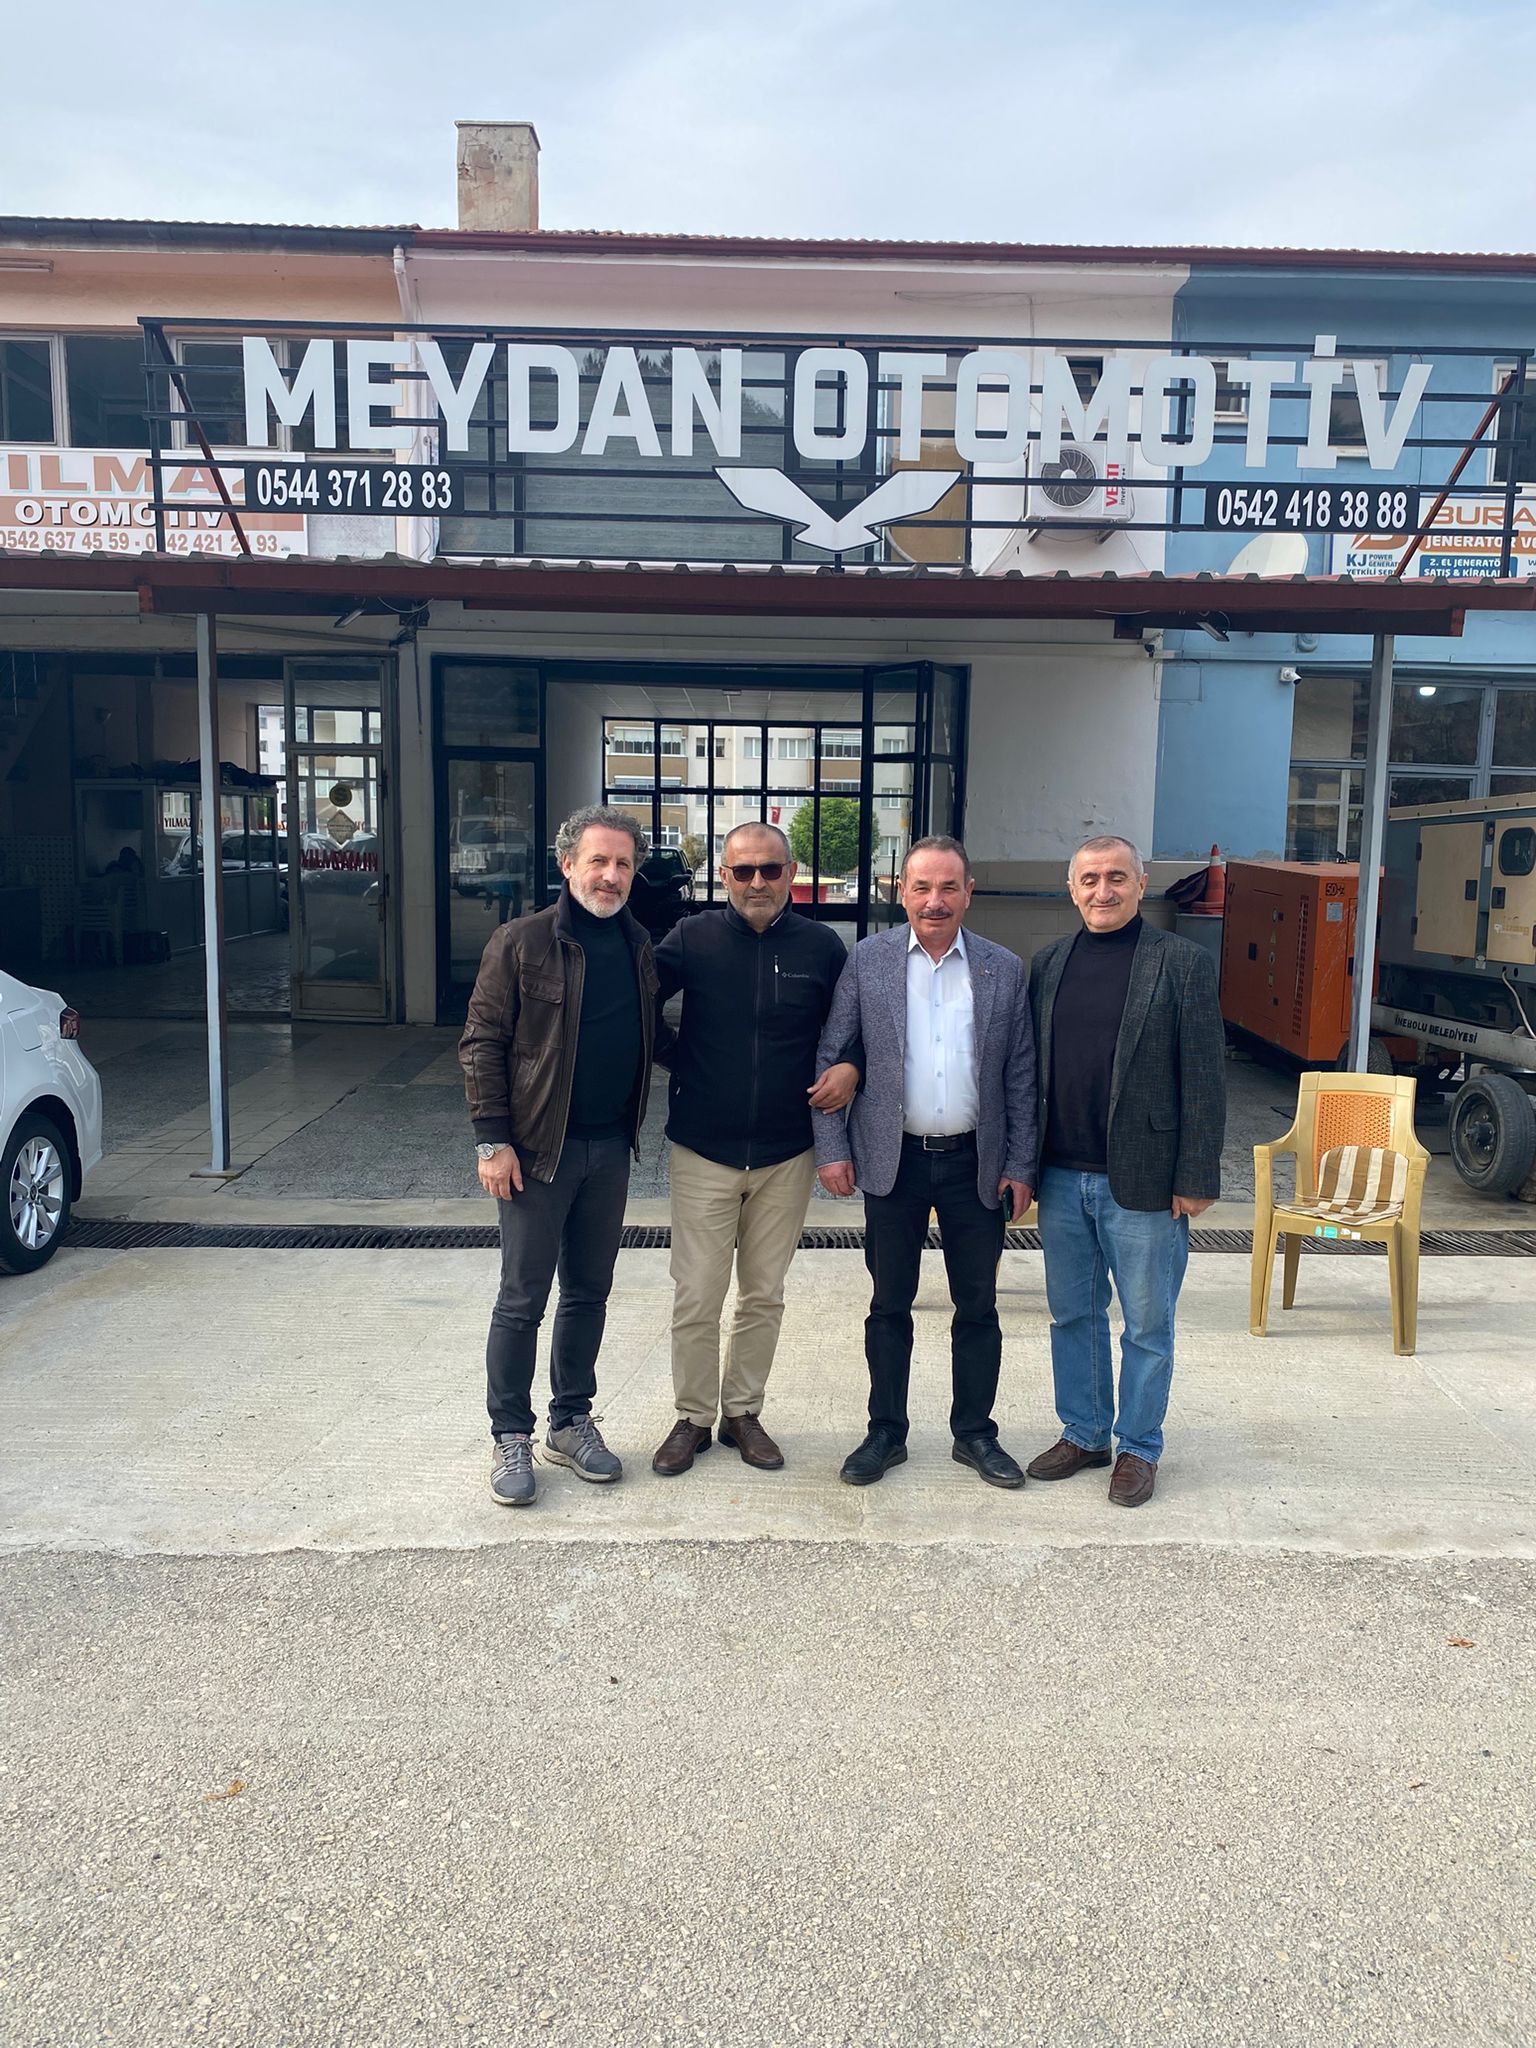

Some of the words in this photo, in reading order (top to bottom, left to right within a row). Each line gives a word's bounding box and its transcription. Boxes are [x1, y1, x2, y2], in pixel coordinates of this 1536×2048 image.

[242, 336, 743, 458] MEYDAN
[793, 335, 1434, 470] OTOMOTİV
[0, 453, 244, 497] ILMA
[257, 467, 320, 506] 0544
[327, 469, 371, 507] 371
[381, 470, 413, 508] 28
[421, 471, 452, 509] 83
[1217, 488, 1278, 526] 0542
[1285, 489, 1331, 527] 418
[1338, 490, 1369, 528] 38
[1376, 491, 1407, 529] 88
[0, 530, 39, 549] 0542
[44, 531, 76, 549] 637
[82, 532, 102, 549] 45
[108, 533, 129, 550] 59
[145, 533, 188, 551] 042
[193, 534, 223, 552] 421
[230, 535, 251, 553] 2
[256, 535, 278, 552] 93
[1346, 554, 1367, 567] KJ
[1441, 559, 1452, 567] EL
[1453, 559, 1501, 567] JENERATÖ
[1424, 568, 1451, 578] SATIŞ
[1463, 567, 1511, 577] KİRALA
[1429, 1024, 1478, 1044] BELEDİYESİ
